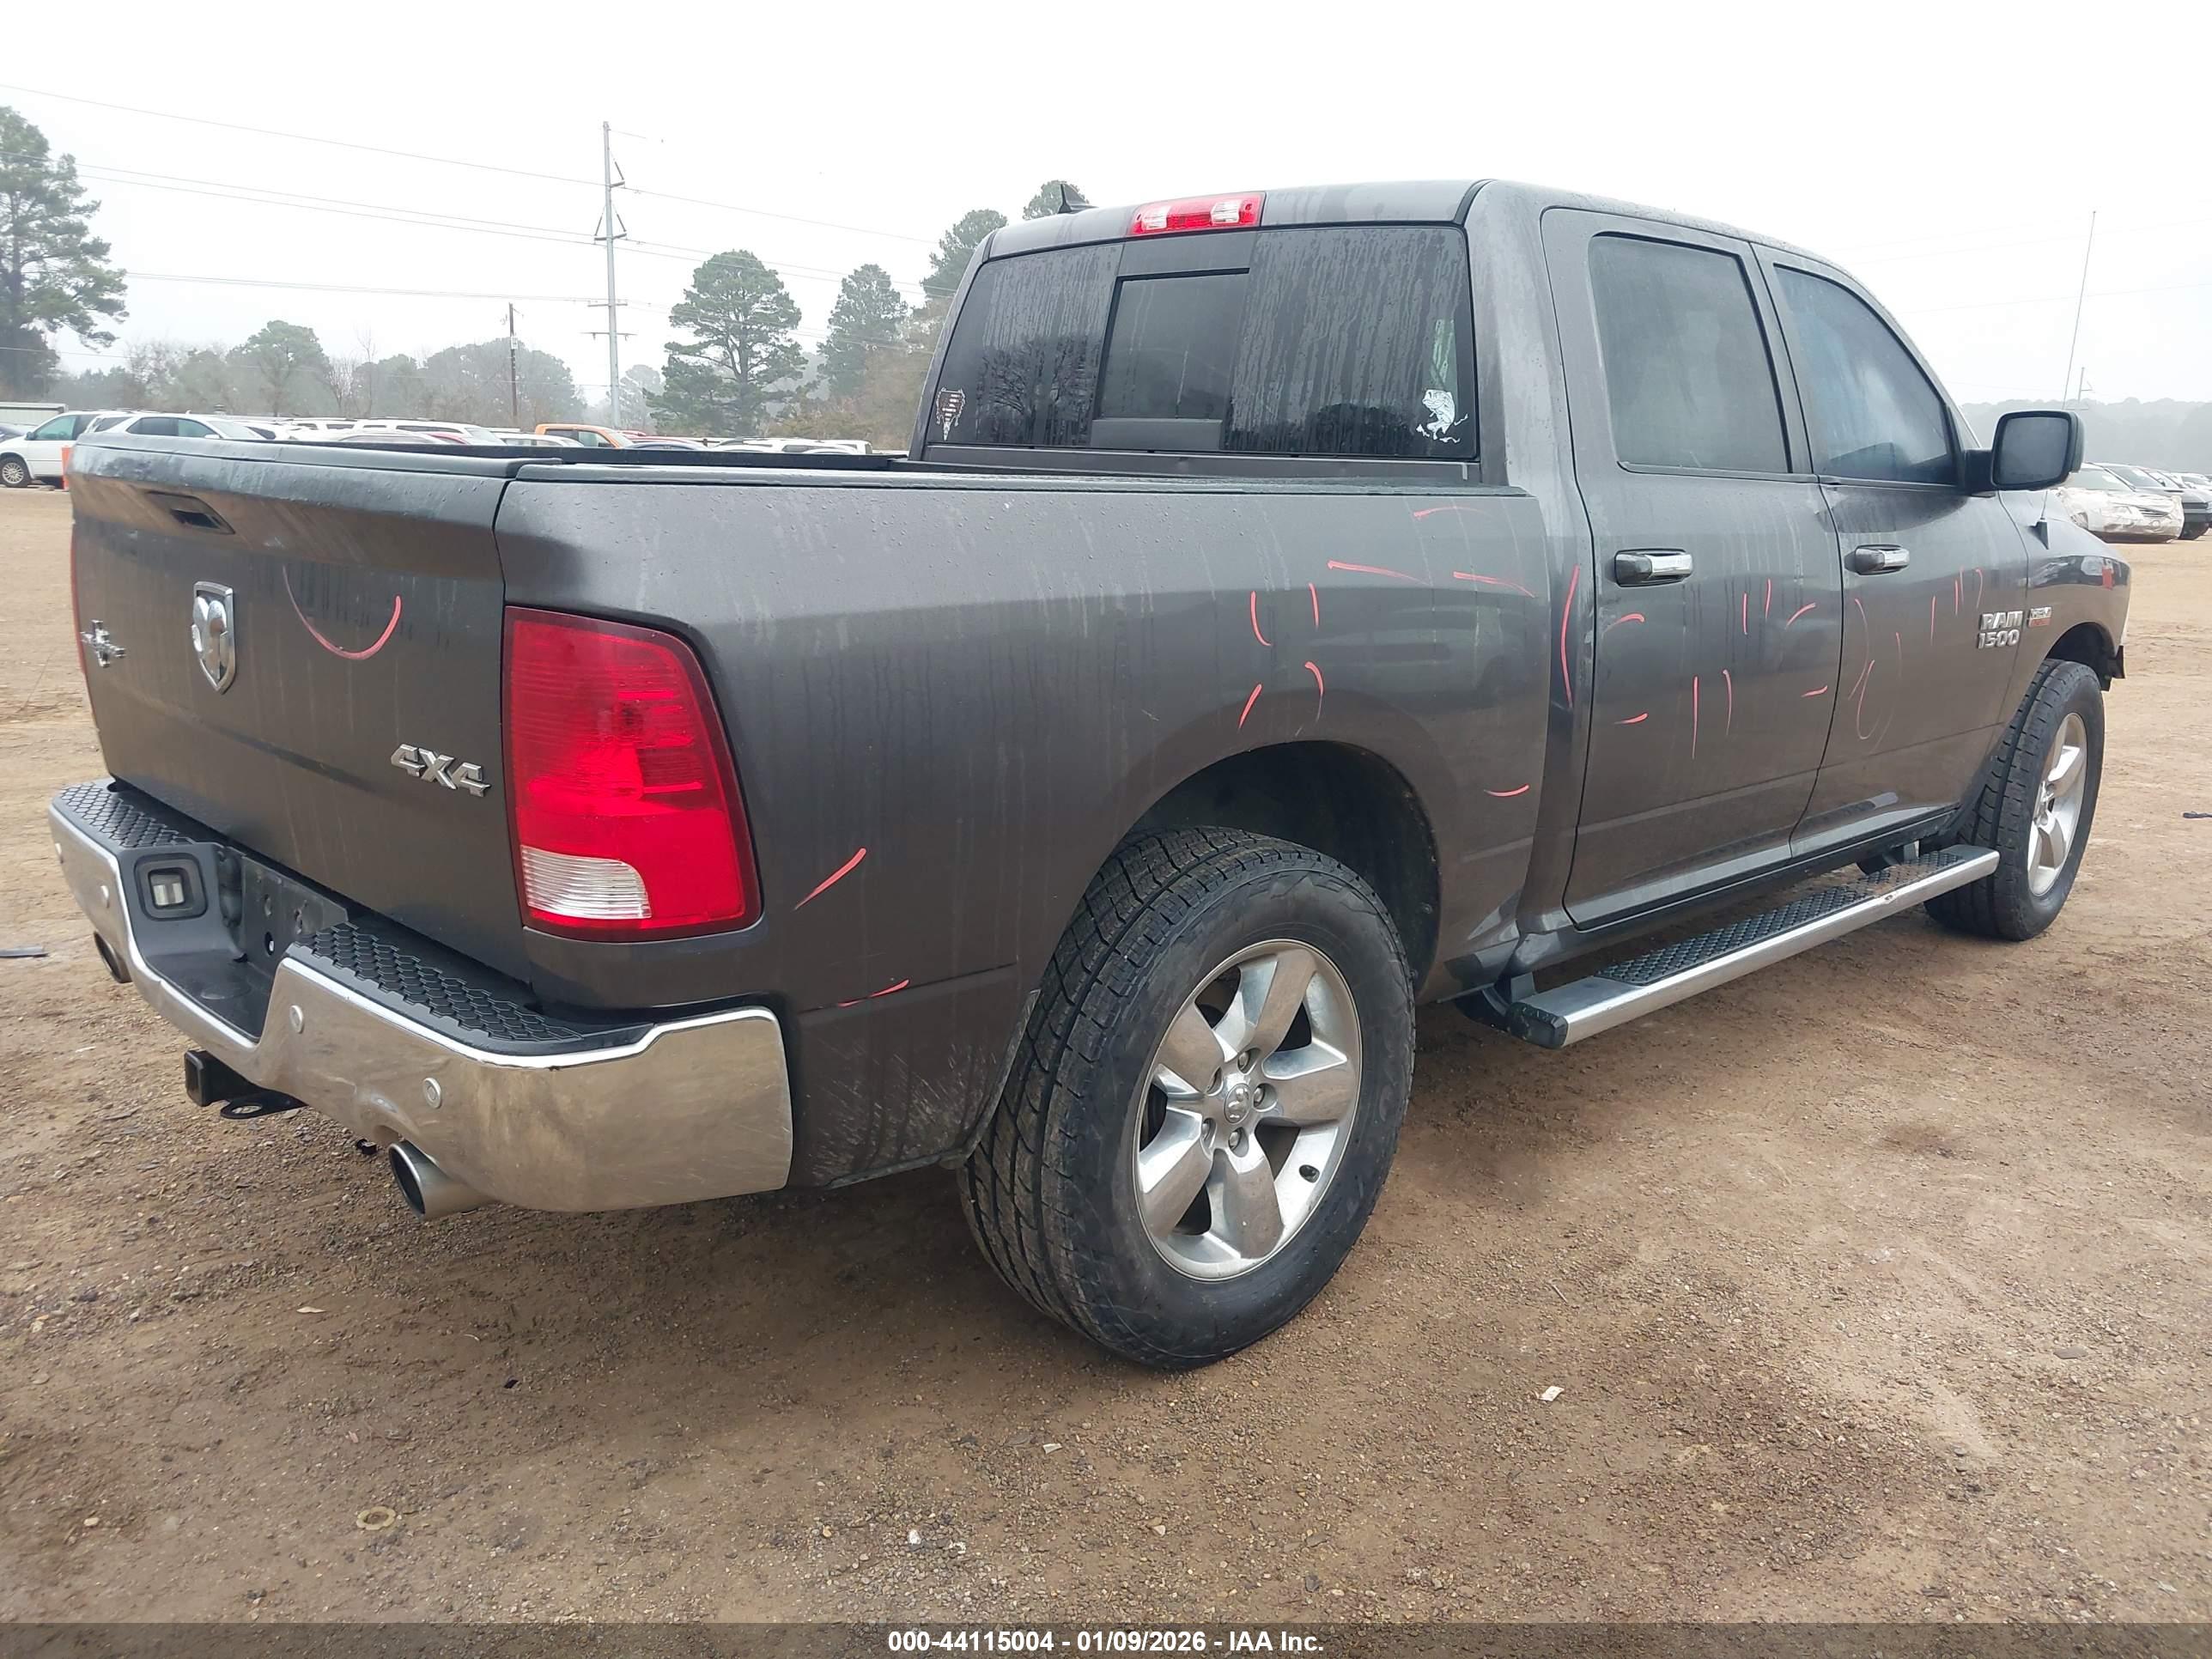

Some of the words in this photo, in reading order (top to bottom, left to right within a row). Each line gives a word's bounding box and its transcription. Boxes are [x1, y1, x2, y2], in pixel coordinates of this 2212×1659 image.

[1980, 611, 2023, 630] RAM
[1978, 629, 2020, 649] 1500
[391, 743, 491, 798] 4X4
